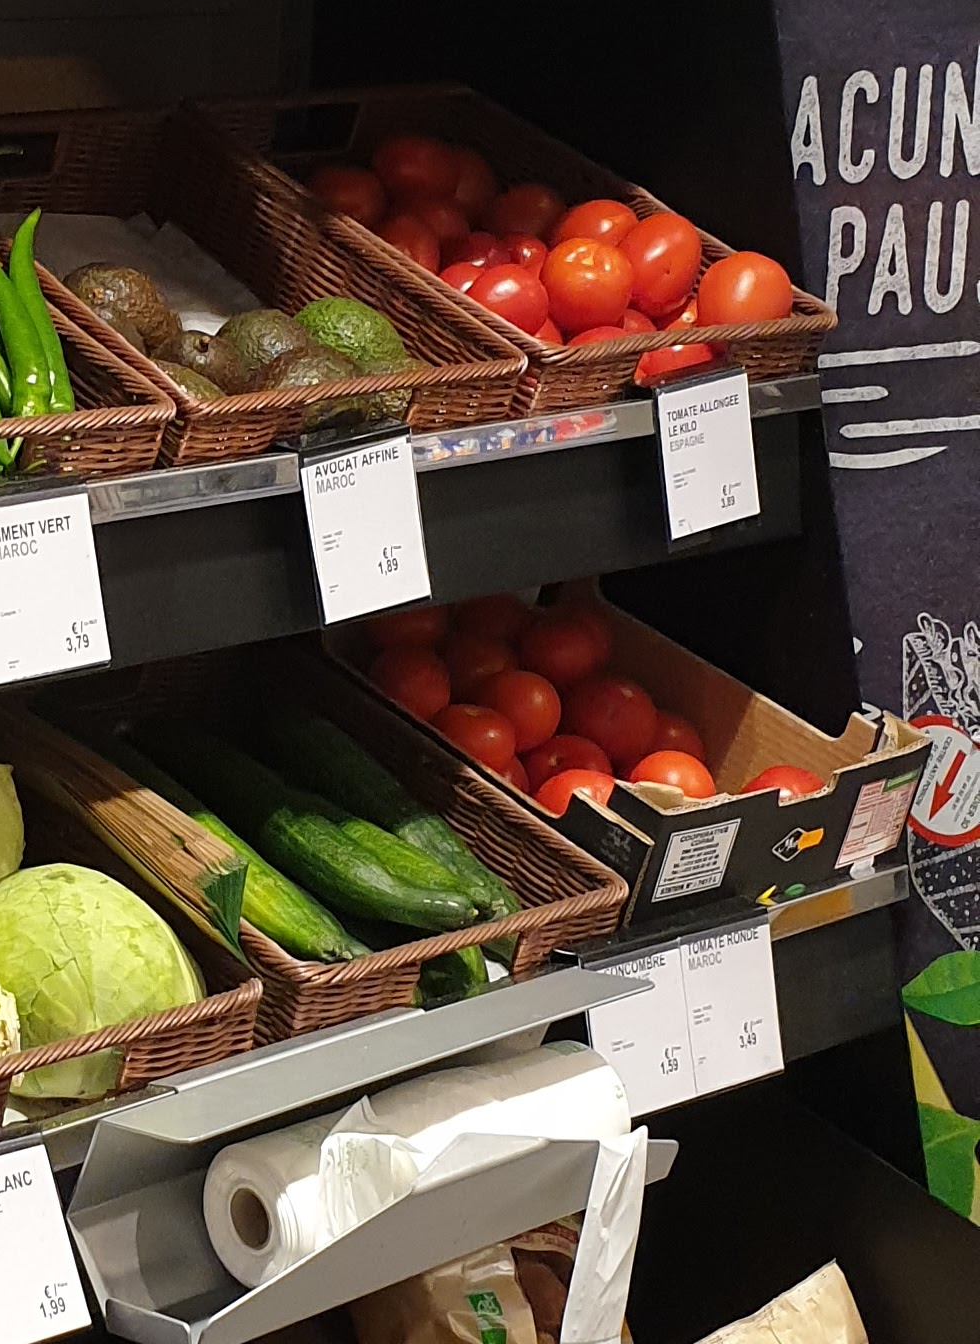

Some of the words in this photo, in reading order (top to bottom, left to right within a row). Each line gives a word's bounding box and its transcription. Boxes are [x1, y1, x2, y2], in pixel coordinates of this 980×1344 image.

[825, 199, 980, 316] PAU
[666, 404, 698, 422] TOMATE
[668, 425, 678, 437] LE
[680, 421, 697, 434] KILO
[669, 433, 705, 452] ESPAGNE
[314, 456, 359, 479] AVOCAT
[361, 447, 399, 467] AFFINE
[316, 472, 356, 494] MAROC
[38, 515, 72, 535] VERT
[65, 633, 89, 653] 3,79
[687, 936, 725, 956] TOMATE
[727, 927, 759, 947] RONDE
[687, 951, 722, 971] MAROC
[739, 1032, 757, 1049] 3,49
[660, 1058, 679, 1074] 1,59
[39, 1297, 66, 1319] 1,99
